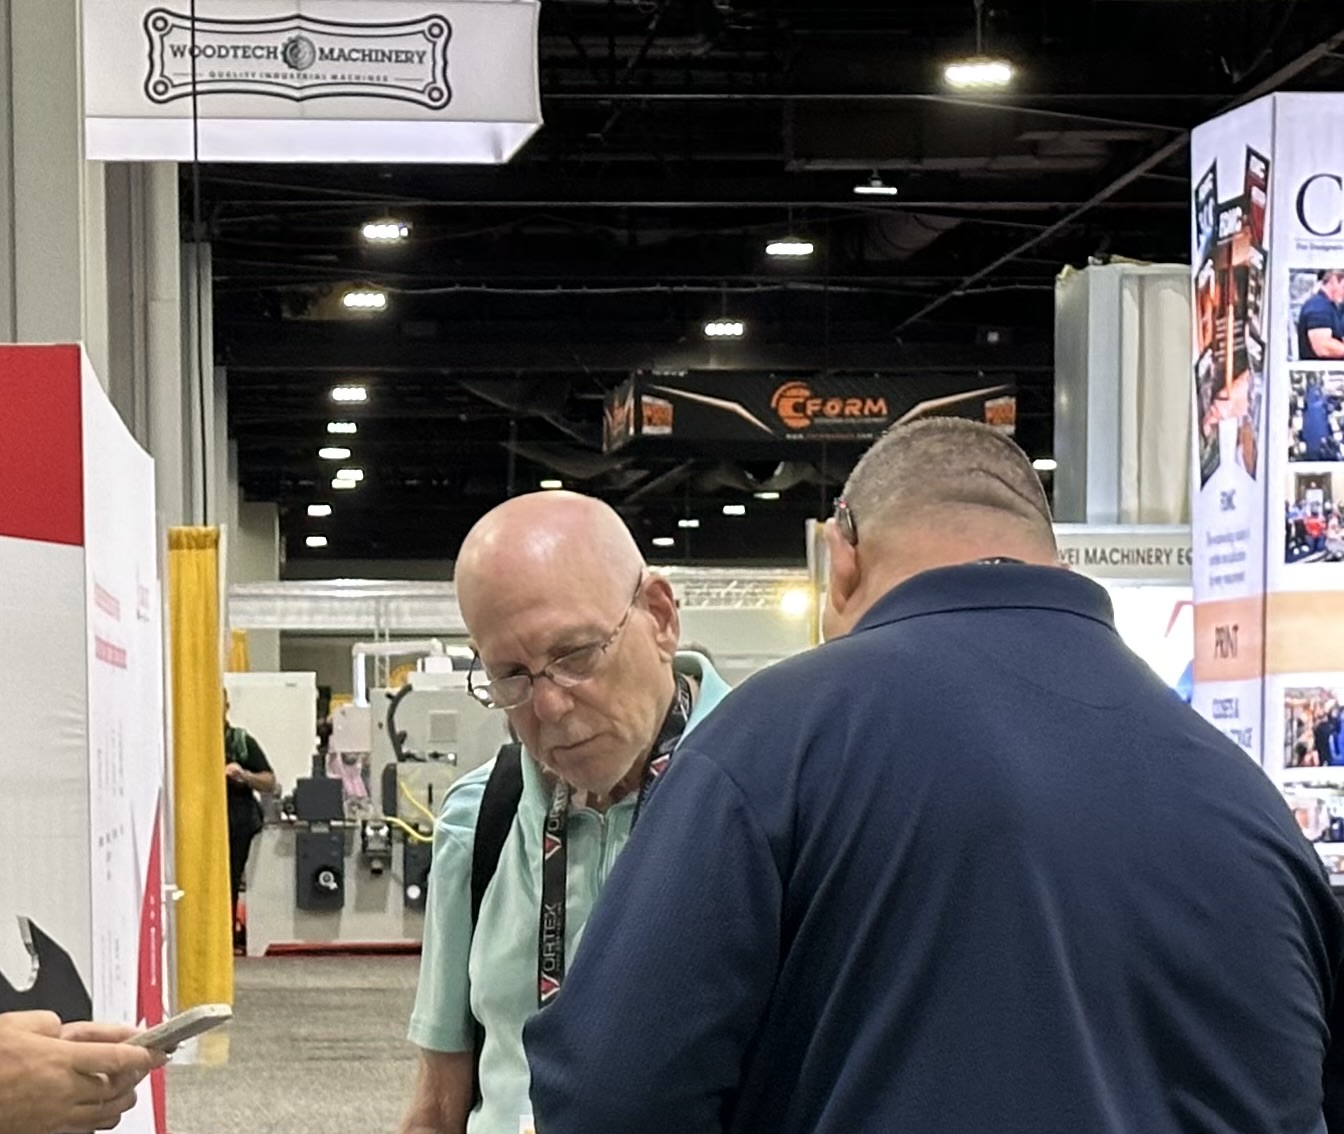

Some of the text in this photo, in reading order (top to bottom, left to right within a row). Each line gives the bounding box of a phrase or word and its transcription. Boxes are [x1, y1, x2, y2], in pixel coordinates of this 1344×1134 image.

[169, 44, 427, 64] WOODTECH MACHINERY
[1084, 547, 1174, 566] MACHINERY
